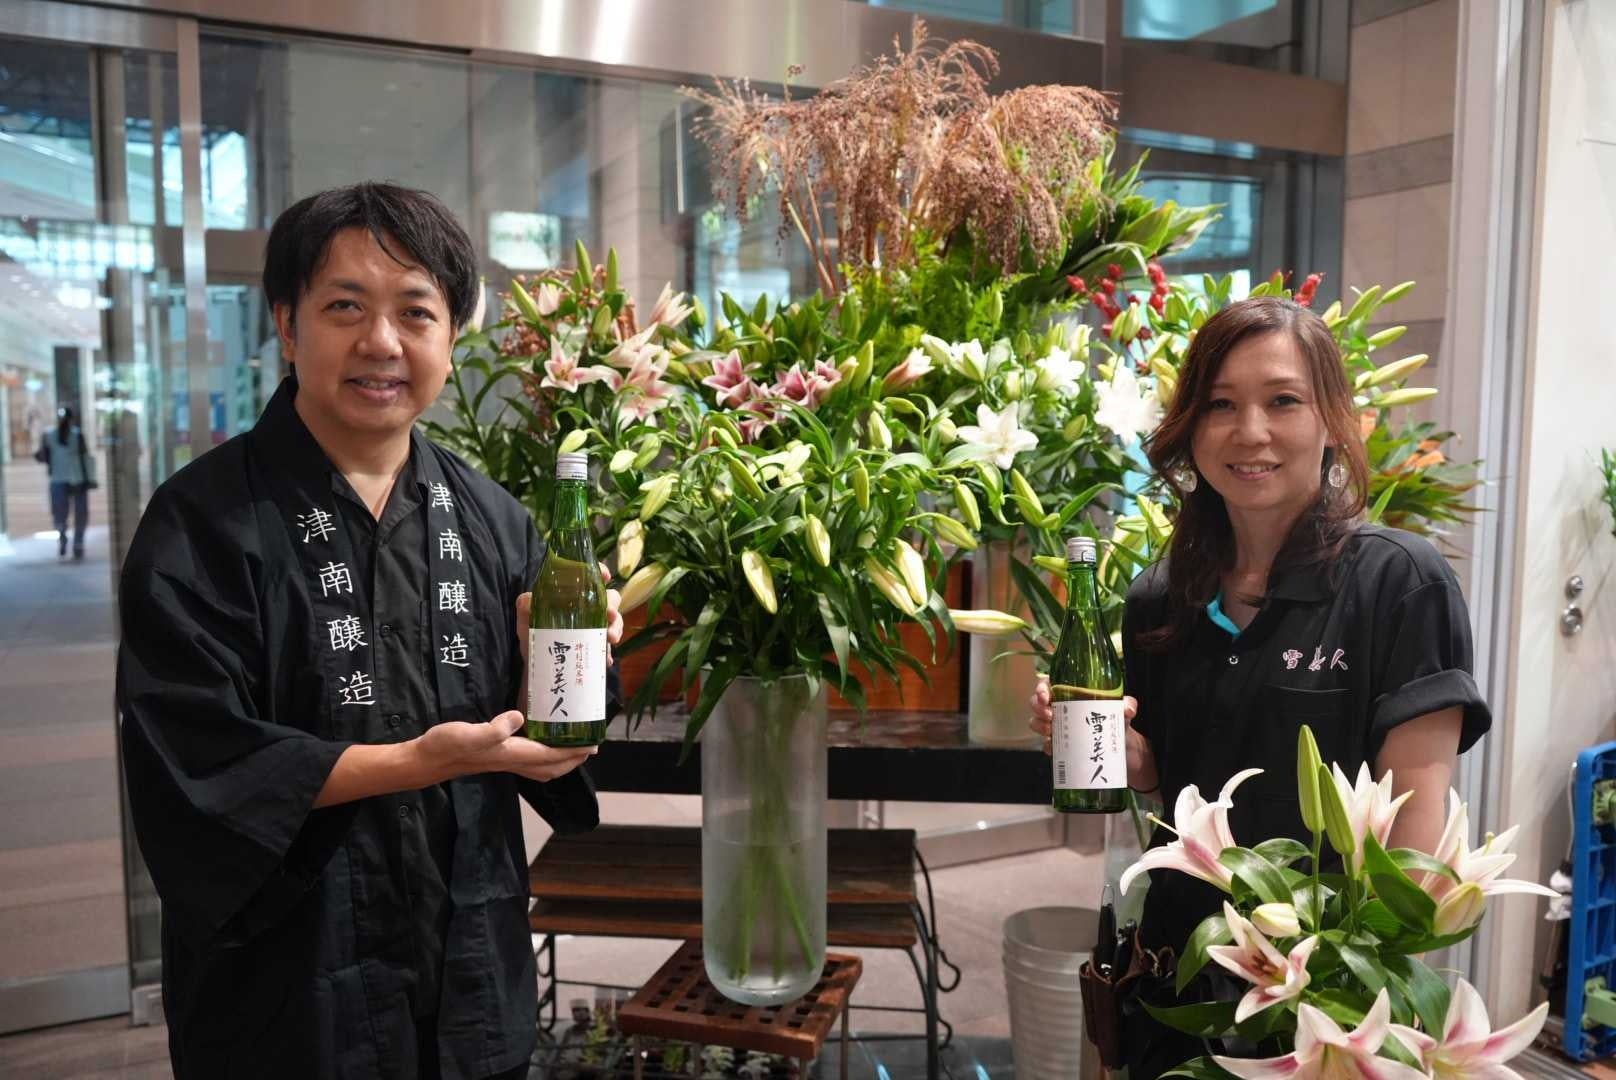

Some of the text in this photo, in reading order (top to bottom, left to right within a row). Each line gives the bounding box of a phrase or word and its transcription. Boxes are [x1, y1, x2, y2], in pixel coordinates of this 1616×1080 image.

[296, 508, 376, 706] 津南醸造
[429, 482, 471, 668] 津南醸造
[548, 640, 571, 717] 雪美人
[1085, 711, 1108, 785] 雪美人
